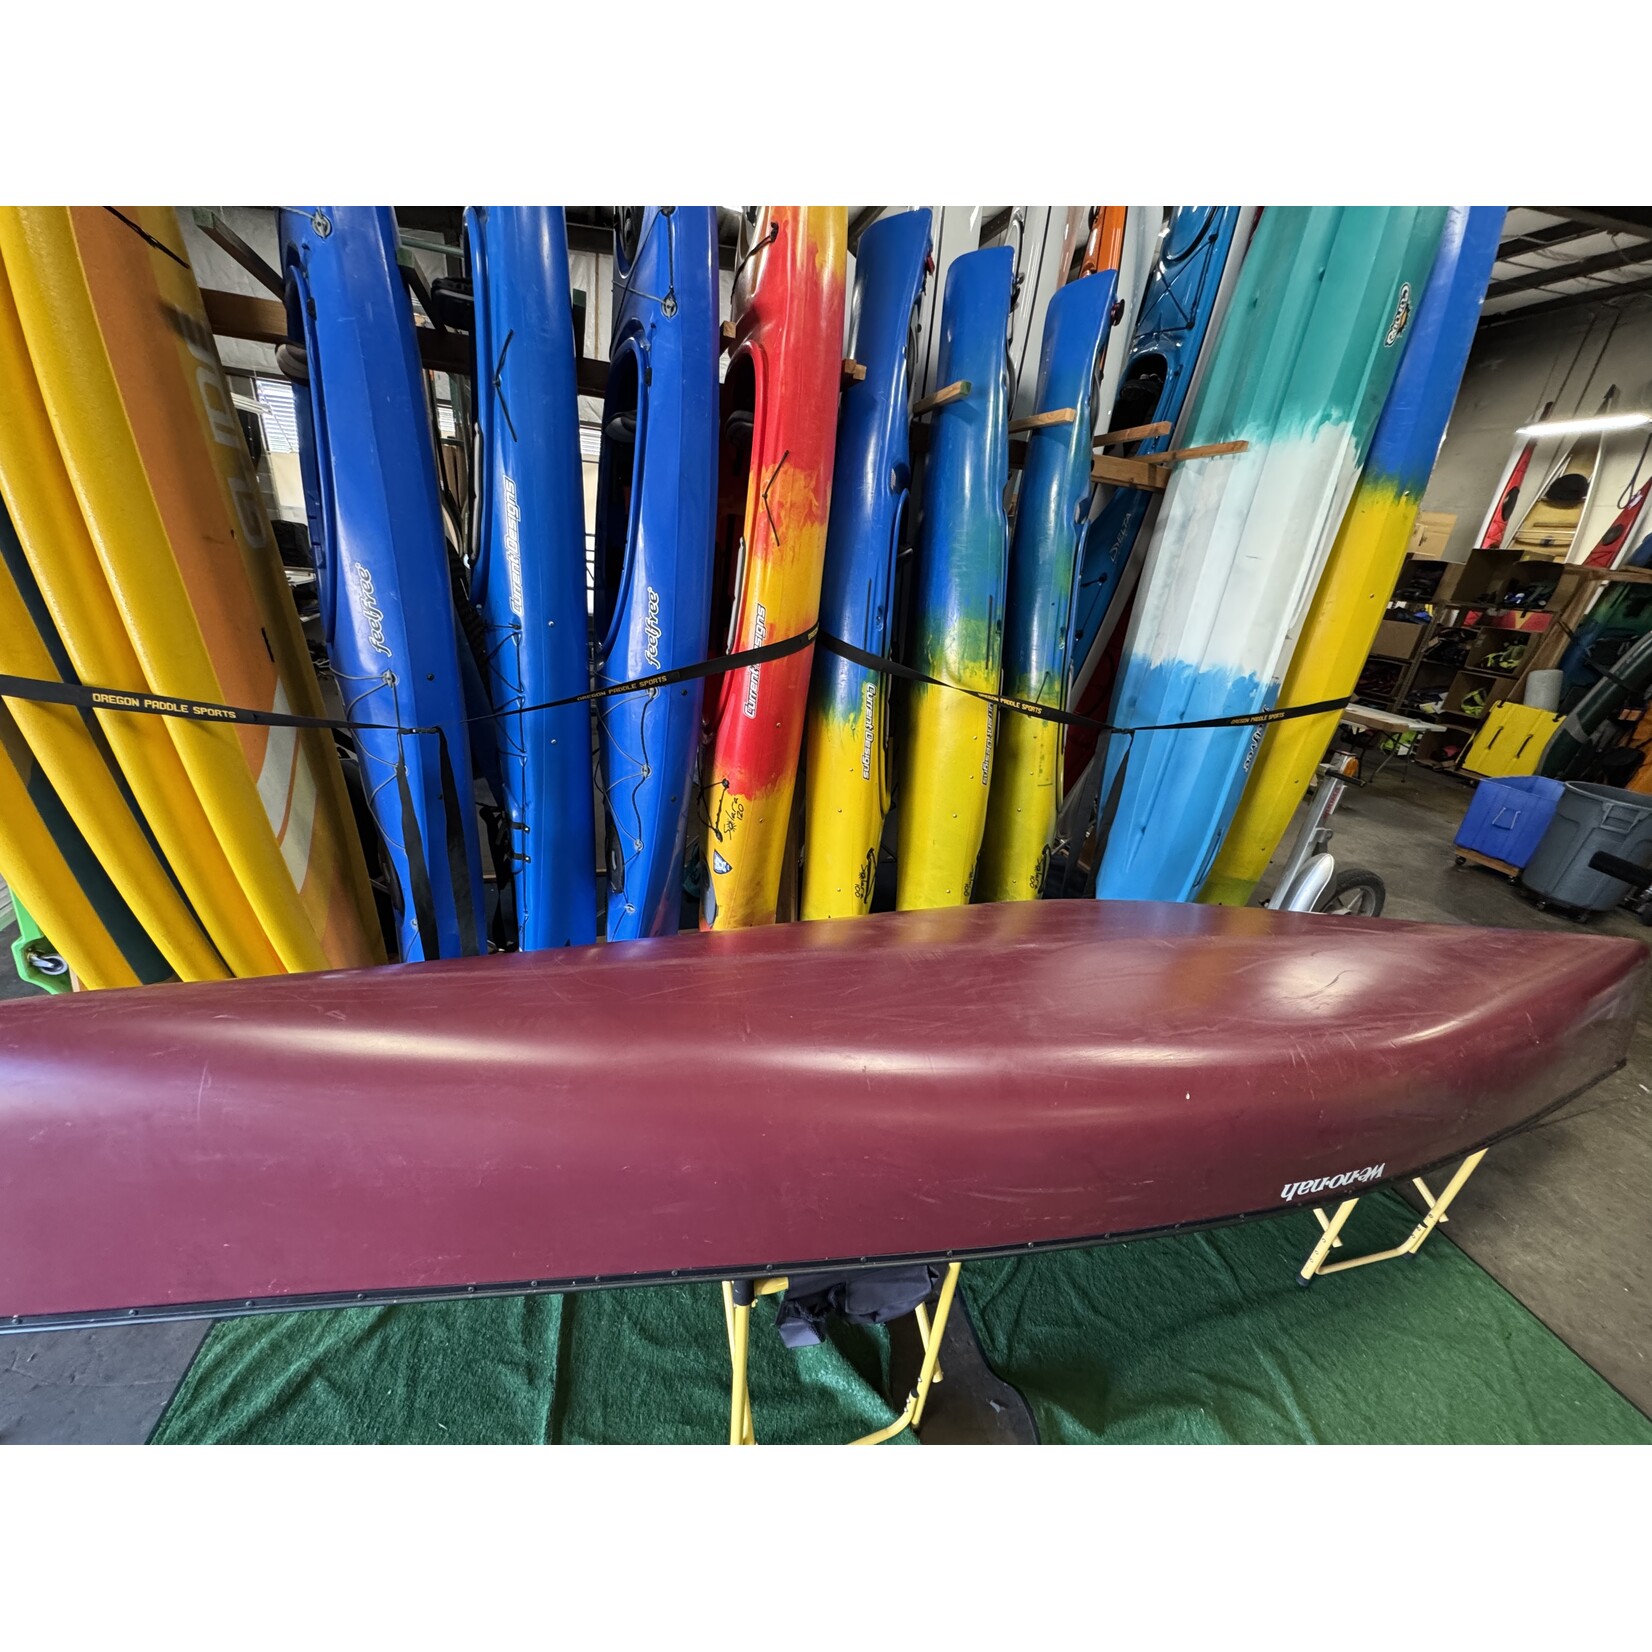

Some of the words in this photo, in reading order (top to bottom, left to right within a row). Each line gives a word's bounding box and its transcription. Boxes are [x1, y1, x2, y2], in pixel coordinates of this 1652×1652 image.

[357, 564, 392, 657] feelfree
[645, 588, 661, 670] feelfree
[608, 683, 637, 694] PADDLE
[639, 675, 667, 687] SPORTS
[92, 693, 140, 707] OREGON
[144, 699, 189, 713] PADDLE
[192, 706, 236, 719] SPORTS
[1022, 703, 1043, 714] SPORTS
[737, 803, 745, 821] 120
